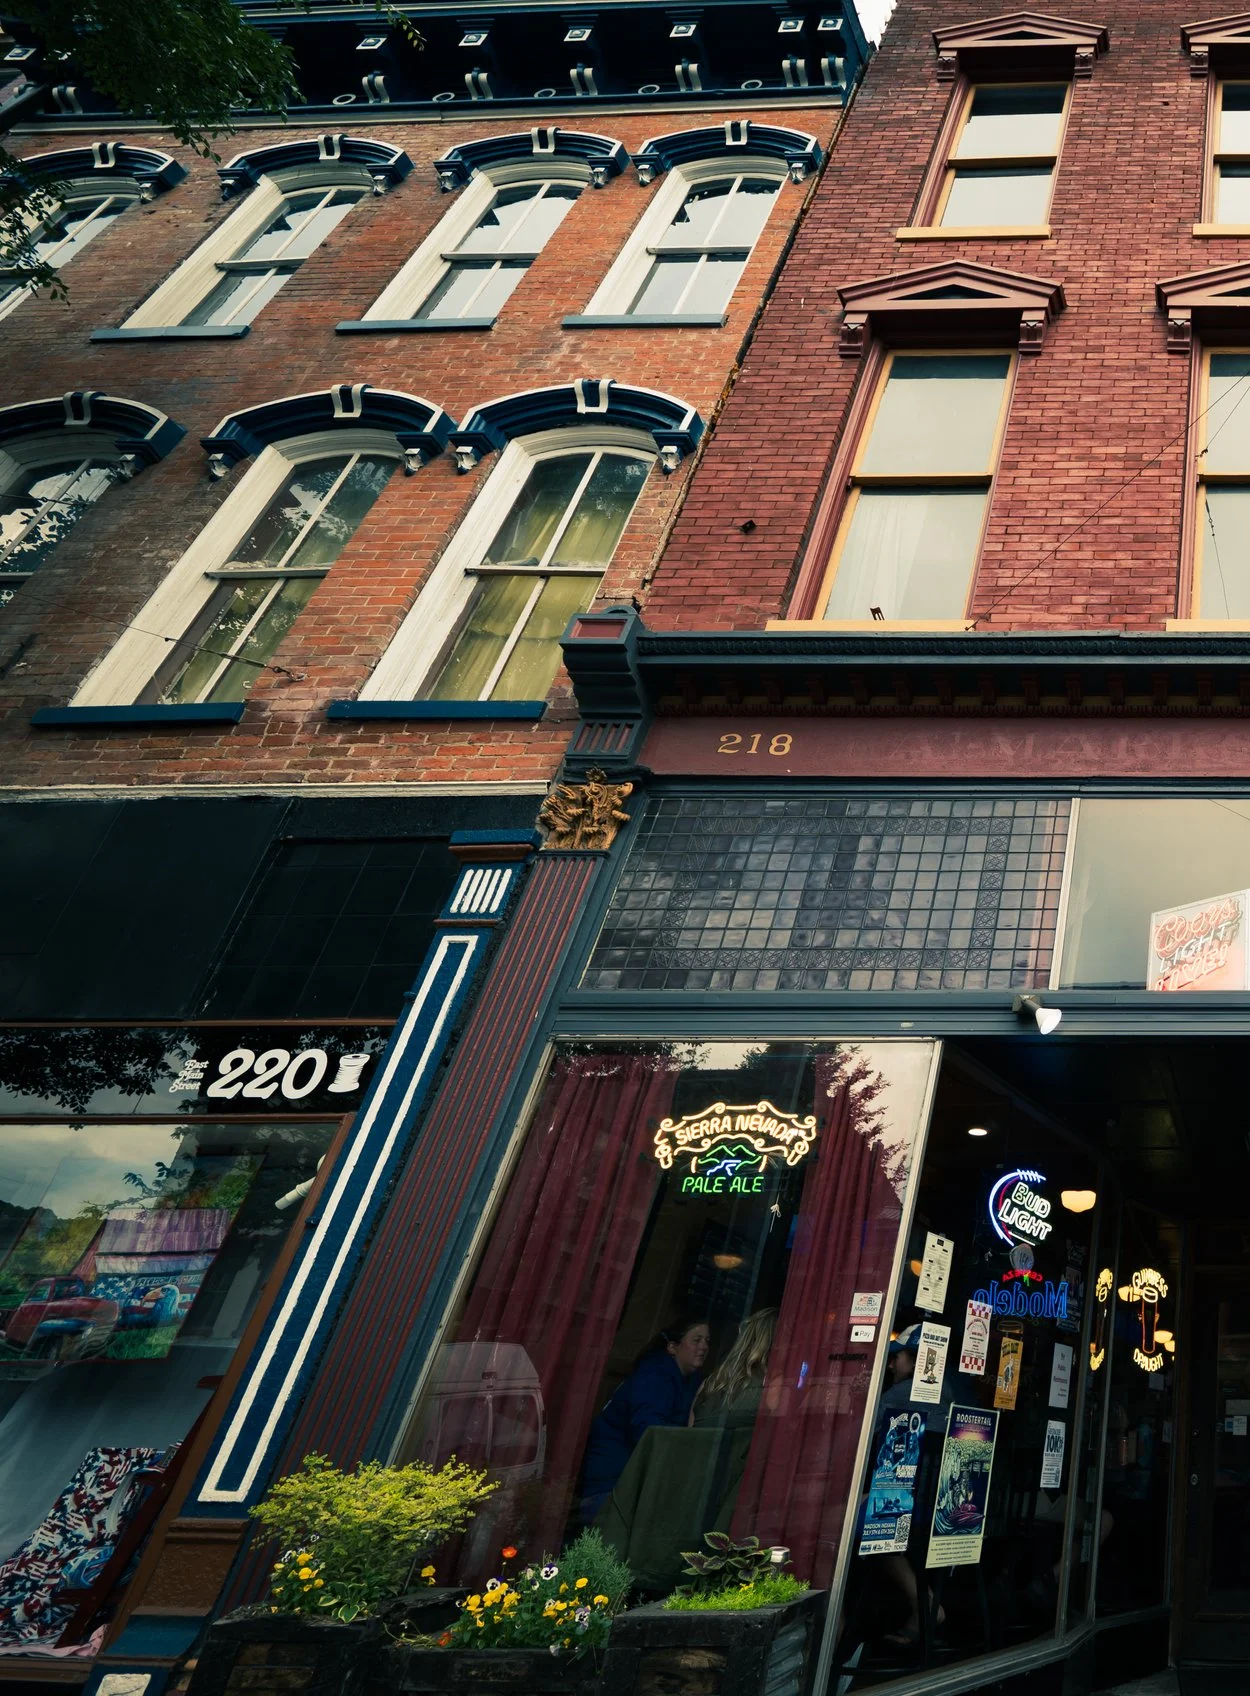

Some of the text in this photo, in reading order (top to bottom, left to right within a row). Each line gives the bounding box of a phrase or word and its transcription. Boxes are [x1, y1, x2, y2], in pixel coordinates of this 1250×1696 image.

[717, 733, 793, 756] 218
[1153, 898, 1243, 955] Coors
[1159, 921, 1232, 973] LIGHT
[178, 1070, 204, 1081] Main
[184, 1060, 209, 1071] East
[206, 1048, 328, 1100] 220
[169, 1080, 201, 1093] Street
[675, 1115, 794, 1145] SIERRA NEVADA
[682, 1176, 765, 1193] PALE ALE
[1011, 1181, 1051, 1219] BUD
[998, 1198, 1053, 1240] LIGHT
[859, 1330, 871, 1338] Pay
[956, 1413, 992, 1426] ROOSTERTAIL
